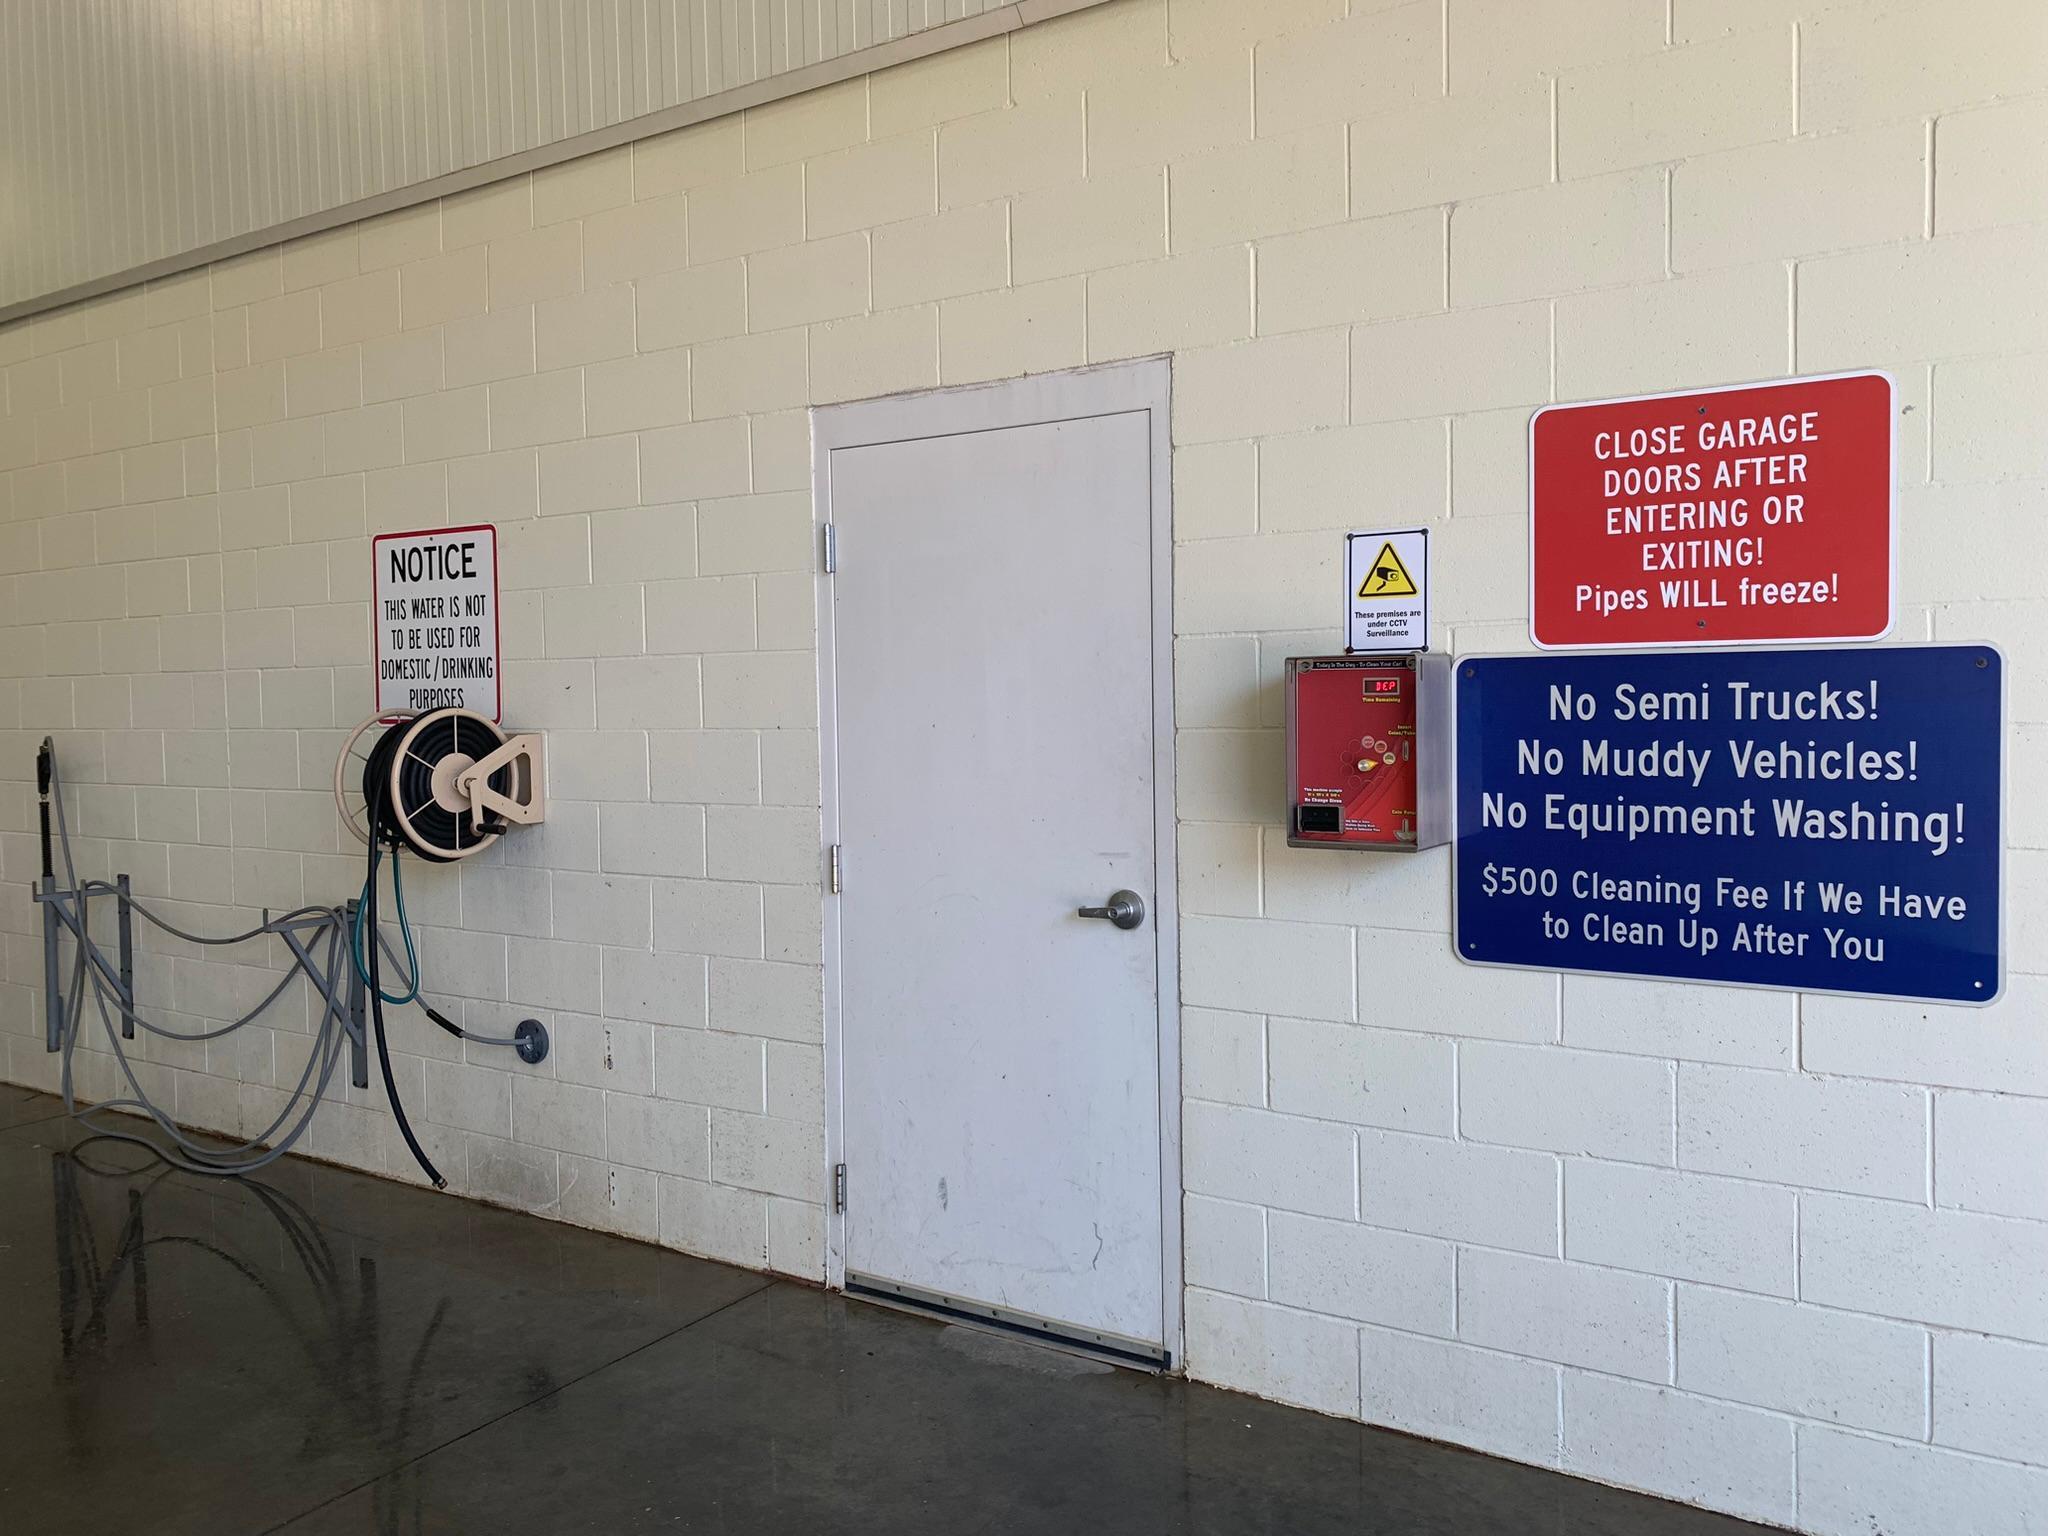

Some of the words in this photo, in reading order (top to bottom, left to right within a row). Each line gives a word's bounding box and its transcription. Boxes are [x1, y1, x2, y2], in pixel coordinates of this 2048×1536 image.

[1594, 424, 1685, 460] CLOSE
[1698, 411, 1818, 451] GARAGE
[1604, 463, 1701, 497] DOORS
[1713, 454, 1807, 489] AFTER
[1607, 498, 1748, 535] ENTERING
[1763, 494, 1804, 525] OR
[391, 542, 477, 583] NOTICE
[1642, 537, 1763, 571] EXITING!
[385, 599, 407, 620] THIS
[411, 597, 444, 619] WATER
[450, 596, 460, 617] IS
[465, 594, 486, 616] NOT
[1376, 610, 1408, 619] premises
[1576, 584, 1649, 617] Pipes
[1659, 578, 1727, 609] WILL
[1739, 573, 1838, 606] freeze!
[391, 629, 404, 650] TO
[409, 628, 421, 649] BE
[427, 627, 454, 649] USED
[460, 626, 480, 648] FOR
[409, 688, 464, 709] PURPOSES
[1549, 684, 1597, 721] No
[1614, 682, 1709, 721] Semi
[1727, 680, 1878, 721] Trucks!
[1518, 739, 1564, 776] No
[1582, 740, 1711, 787] Muddy
[1729, 740, 1918, 781] Vehicles!
[1481, 792, 1527, 829] No
[1544, 794, 1755, 841] Equipment
[1772, 798, 1965, 856] Washing!
[1481, 862, 1557, 898] $500
[1571, 870, 1701, 914] Cleaning
[1716, 877, 1768, 909] Fee
[1783, 880, 1805, 912] If
[1818, 882, 1863, 915] We
[1879, 885, 1966, 921] Have
[1543, 910, 1569, 940] to
[1582, 913, 1663, 947] Clean
[1678, 919, 1719, 956] Up
[1732, 921, 1809, 957] After
[1823, 928, 1884, 963] You
